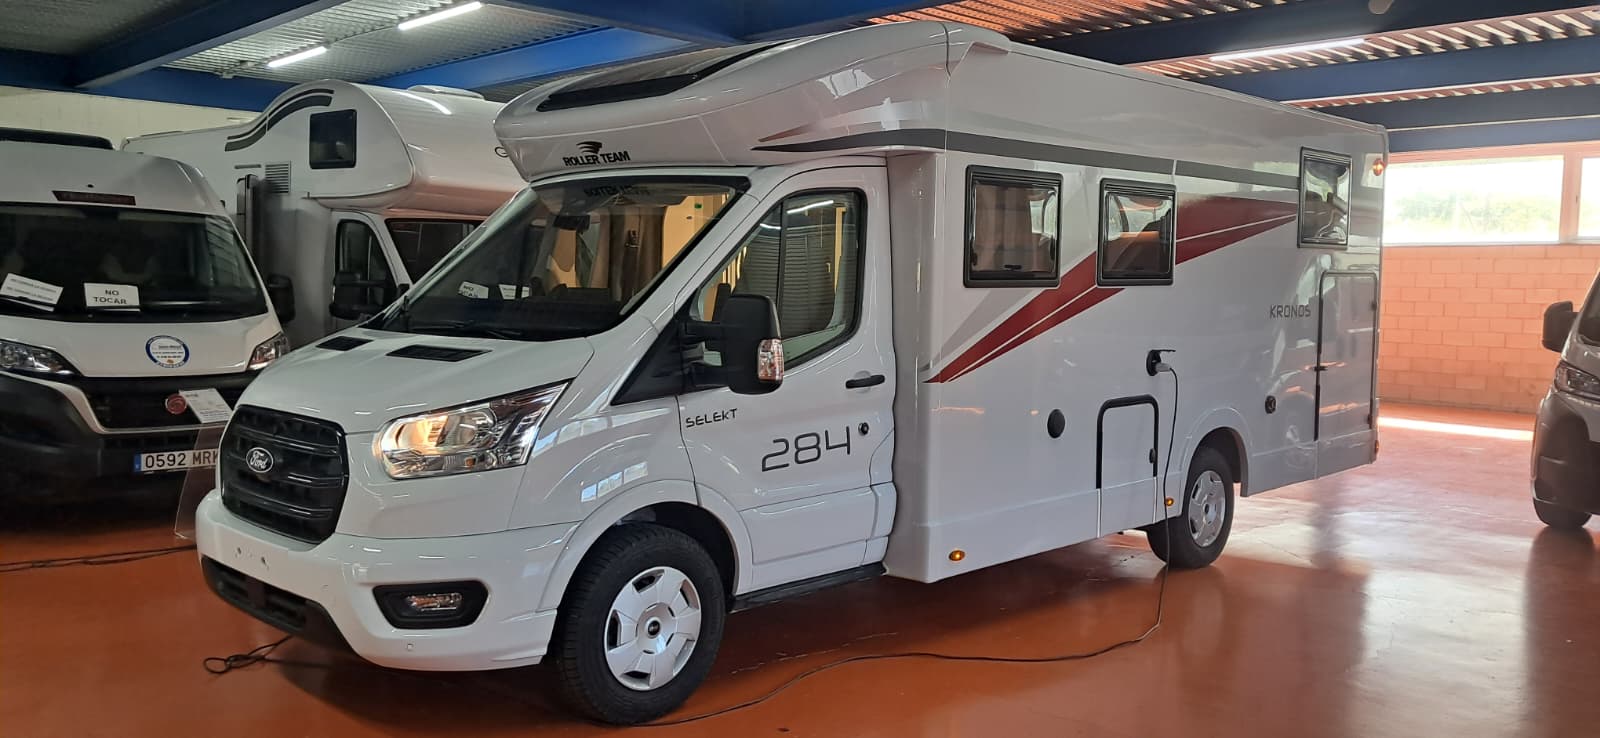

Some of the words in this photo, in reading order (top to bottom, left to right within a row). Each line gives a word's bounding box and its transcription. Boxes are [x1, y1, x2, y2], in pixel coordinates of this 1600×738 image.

[562, 154, 600, 167] ROLLER
[600, 150, 631, 164] TEAM
[104, 288, 120, 296] NO
[93, 296, 127, 305] TOCAR
[1270, 304, 1311, 319] KRONOS
[685, 408, 738, 428] SELEKT
[761, 426, 851, 472] 284
[145, 453, 187, 469] 0592
[249, 449, 270, 470] Ford
